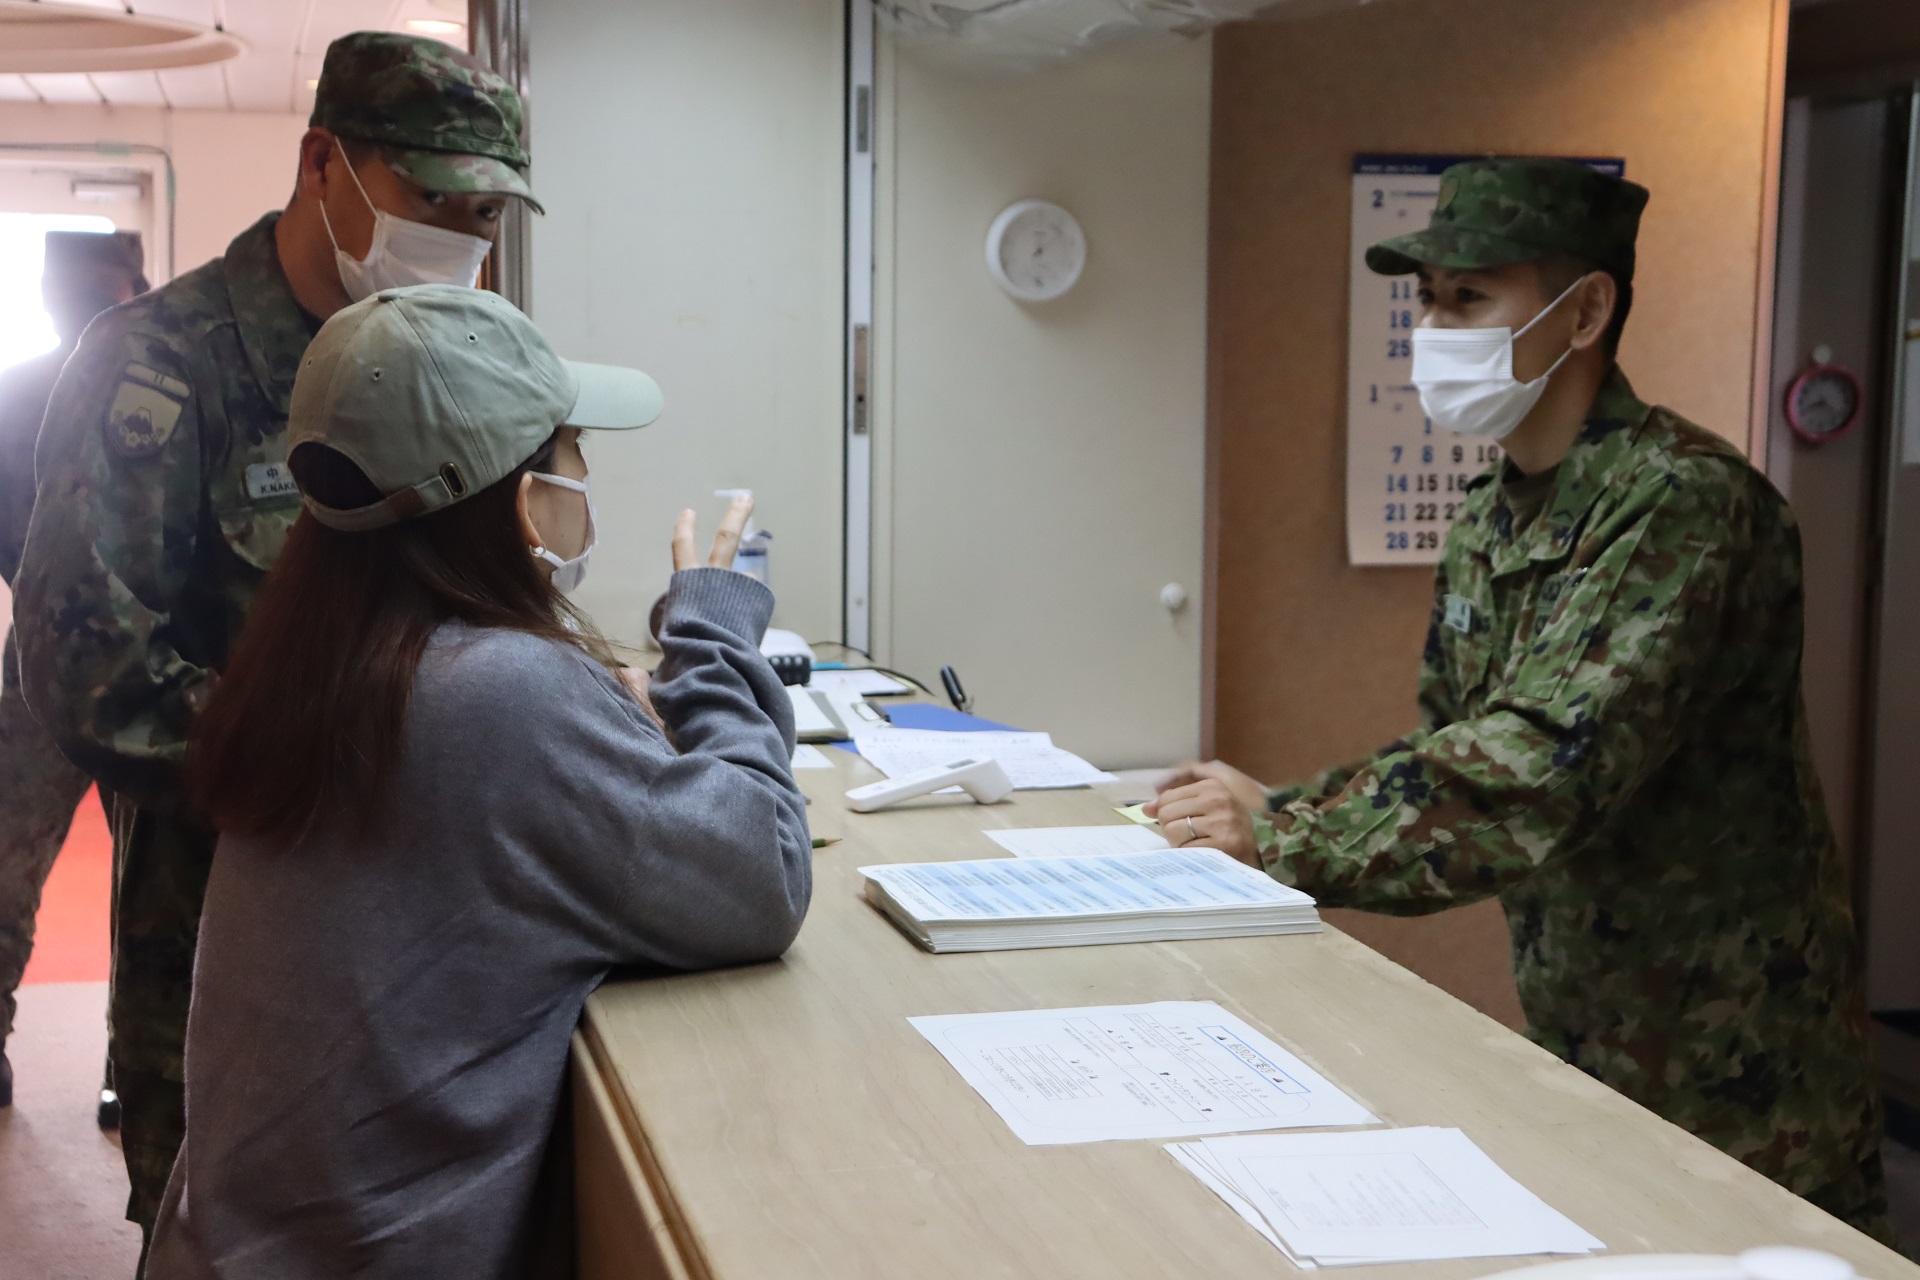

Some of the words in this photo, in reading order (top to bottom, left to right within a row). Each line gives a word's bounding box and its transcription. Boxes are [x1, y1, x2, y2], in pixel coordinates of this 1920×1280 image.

[1372, 188, 1384, 208] 2
[1391, 281, 1410, 300] 11
[1391, 310, 1412, 328] 18
[1387, 340, 1411, 358] 25
[1370, 384, 1378, 403] 1
[1392, 445, 1403, 463] 7
[1422, 445, 1434, 463] 8
[1452, 445, 1464, 463] 9
[1477, 445, 1499, 463] 10
[1386, 474, 1408, 492] 14
[1416, 474, 1439, 492] 15
[1447, 474, 1469, 492] 16
[1385, 503, 1407, 521] 21
[1415, 503, 1438, 521] 22
[1385, 532, 1409, 549] 28
[1415, 532, 1439, 549] 29
